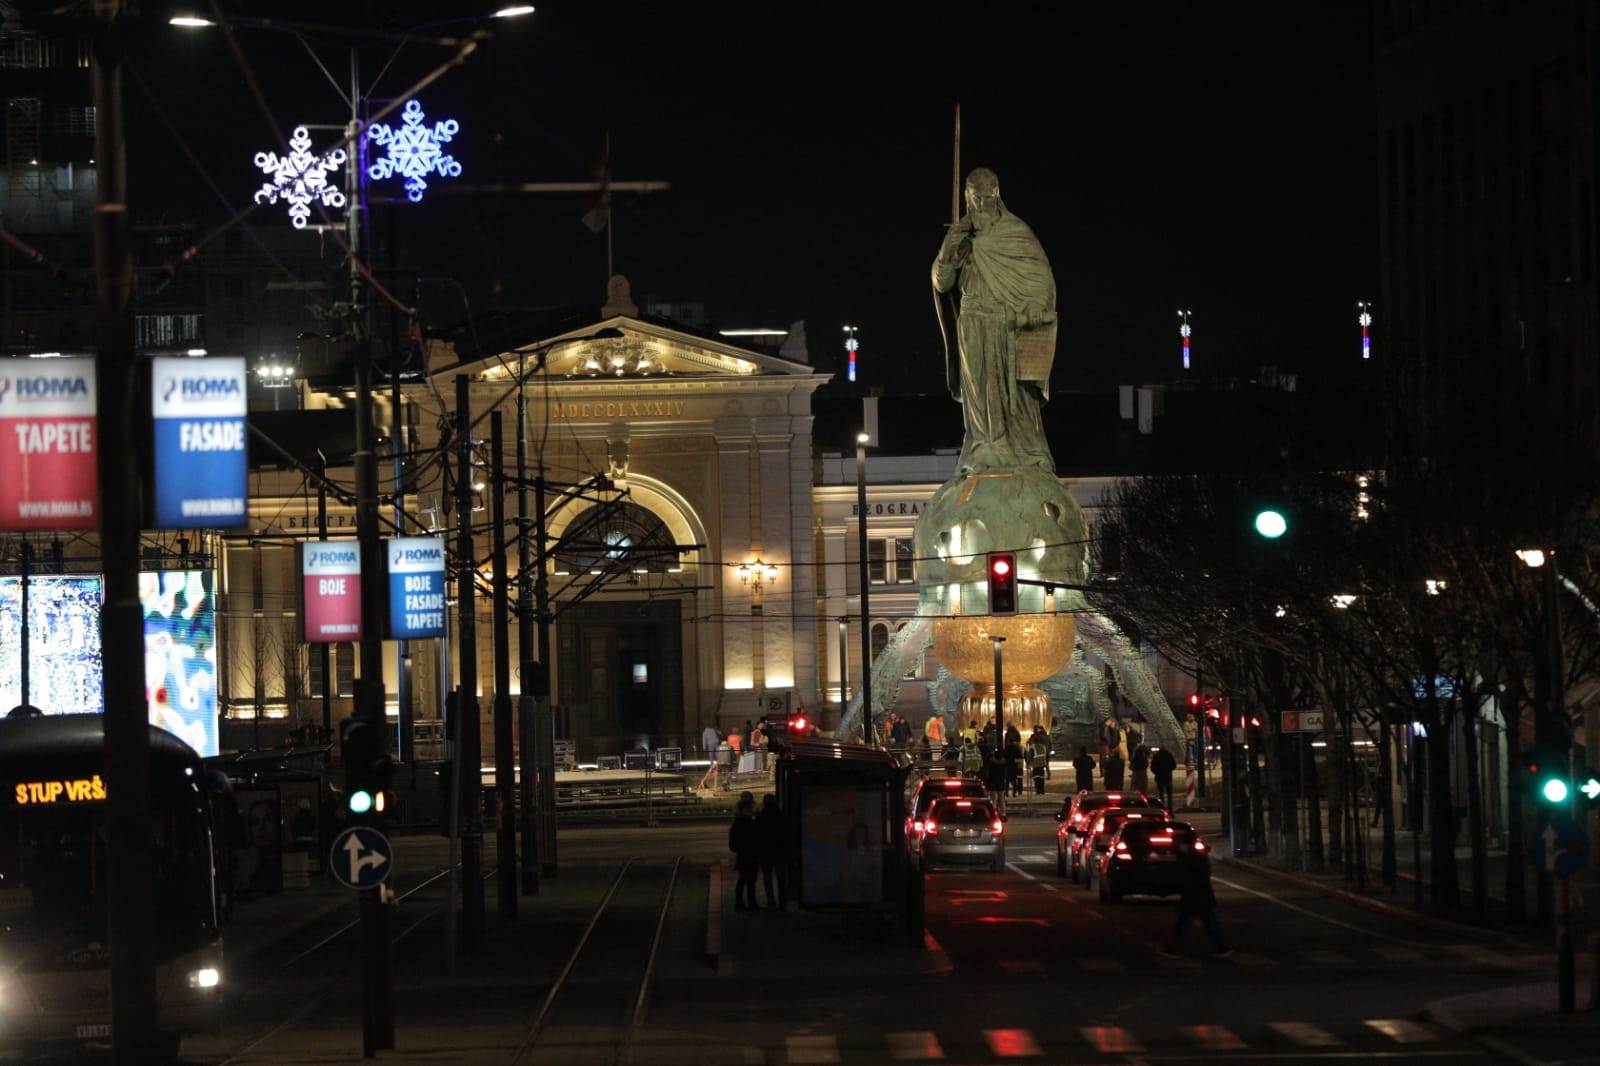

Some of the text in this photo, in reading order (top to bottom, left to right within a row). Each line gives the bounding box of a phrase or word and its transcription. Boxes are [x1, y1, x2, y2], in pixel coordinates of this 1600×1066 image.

[16, 377, 87, 395] ROMA
[182, 377, 240, 394] ROMA
[15, 422, 92, 453] TAPETE
[180, 421, 245, 452] FASADE
[289, 516, 358, 527] БЕОГРА
[320, 552, 357, 563] ROMA
[405, 549, 442, 560] ROMA
[319, 578, 346, 595] BOJE
[405, 576, 432, 592] BOJE
[405, 593, 444, 611] FASADE
[405, 612, 443, 630] TAPETE
[15, 781, 64, 804] STUP
